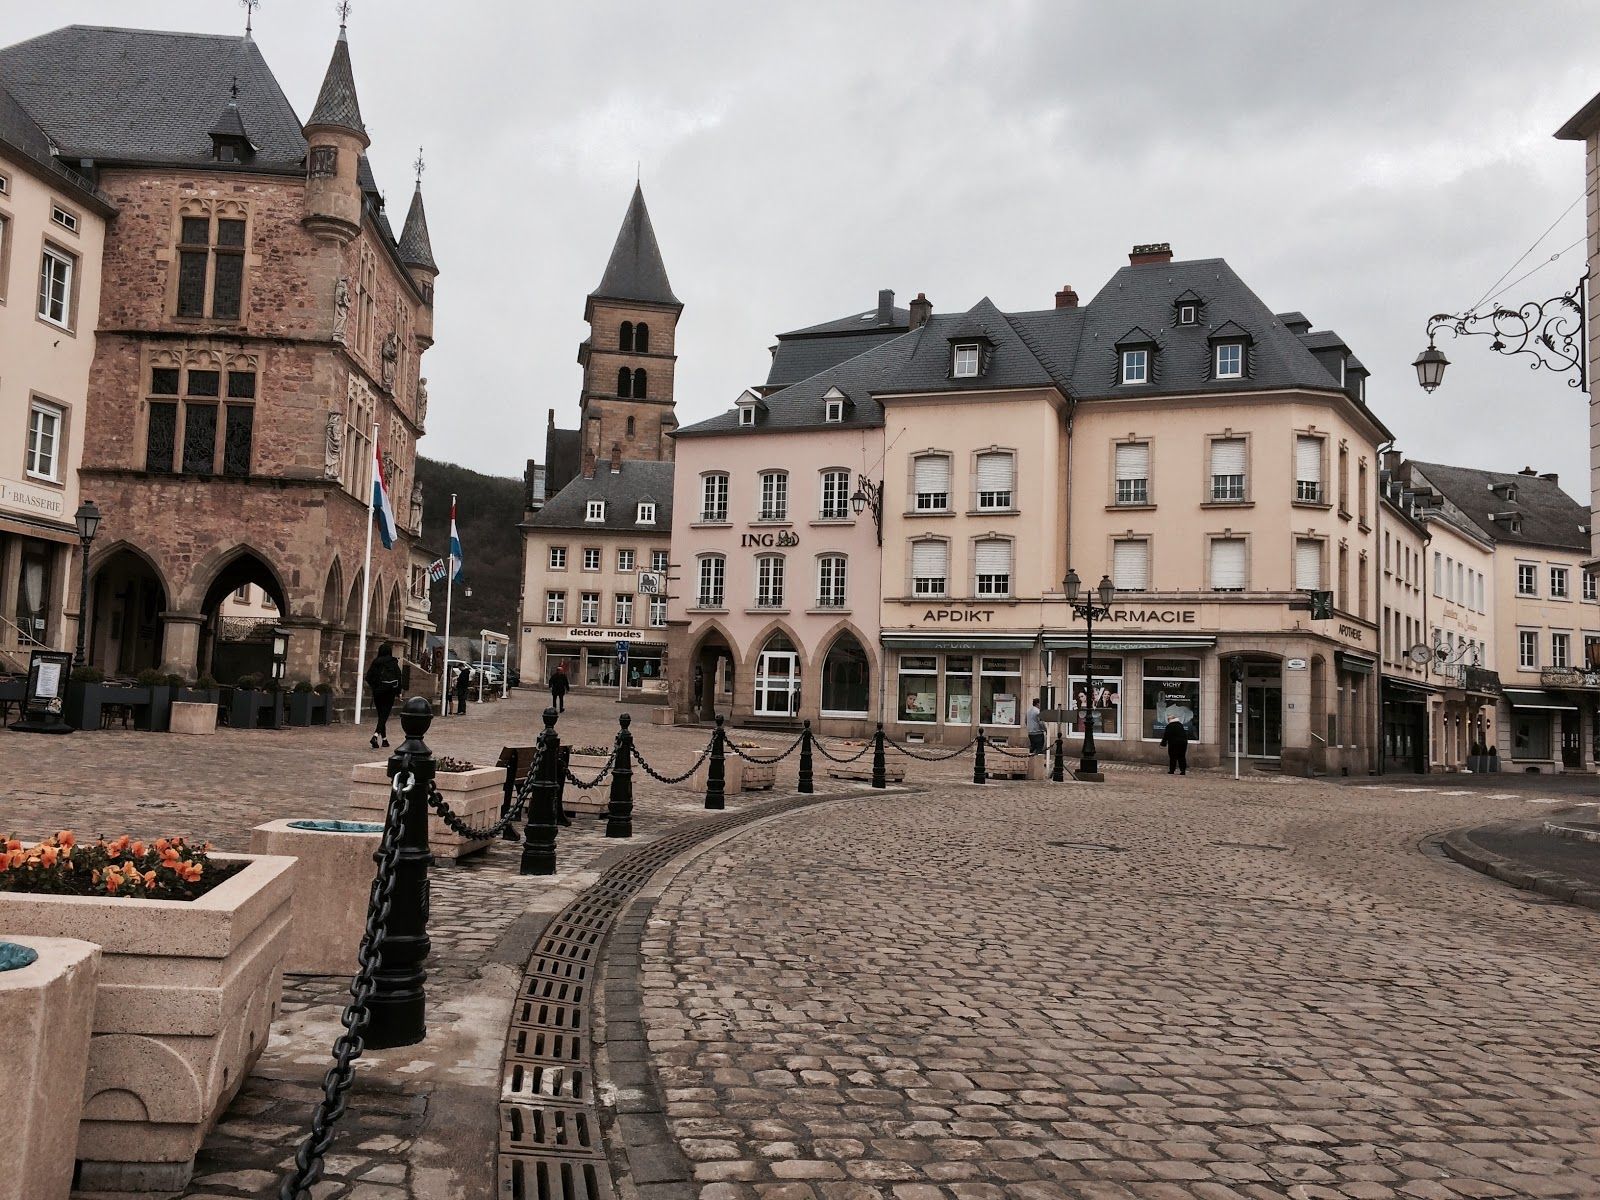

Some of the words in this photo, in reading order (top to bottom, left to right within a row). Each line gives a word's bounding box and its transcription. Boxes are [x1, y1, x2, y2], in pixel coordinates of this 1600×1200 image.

[13, 491, 60, 512] BRASSERIE
[741, 534, 774, 547] ING
[640, 585, 658, 593] ING
[923, 610, 995, 622] APDIKT
[570, 628, 604, 637] decker
[607, 630, 642, 638] modes
